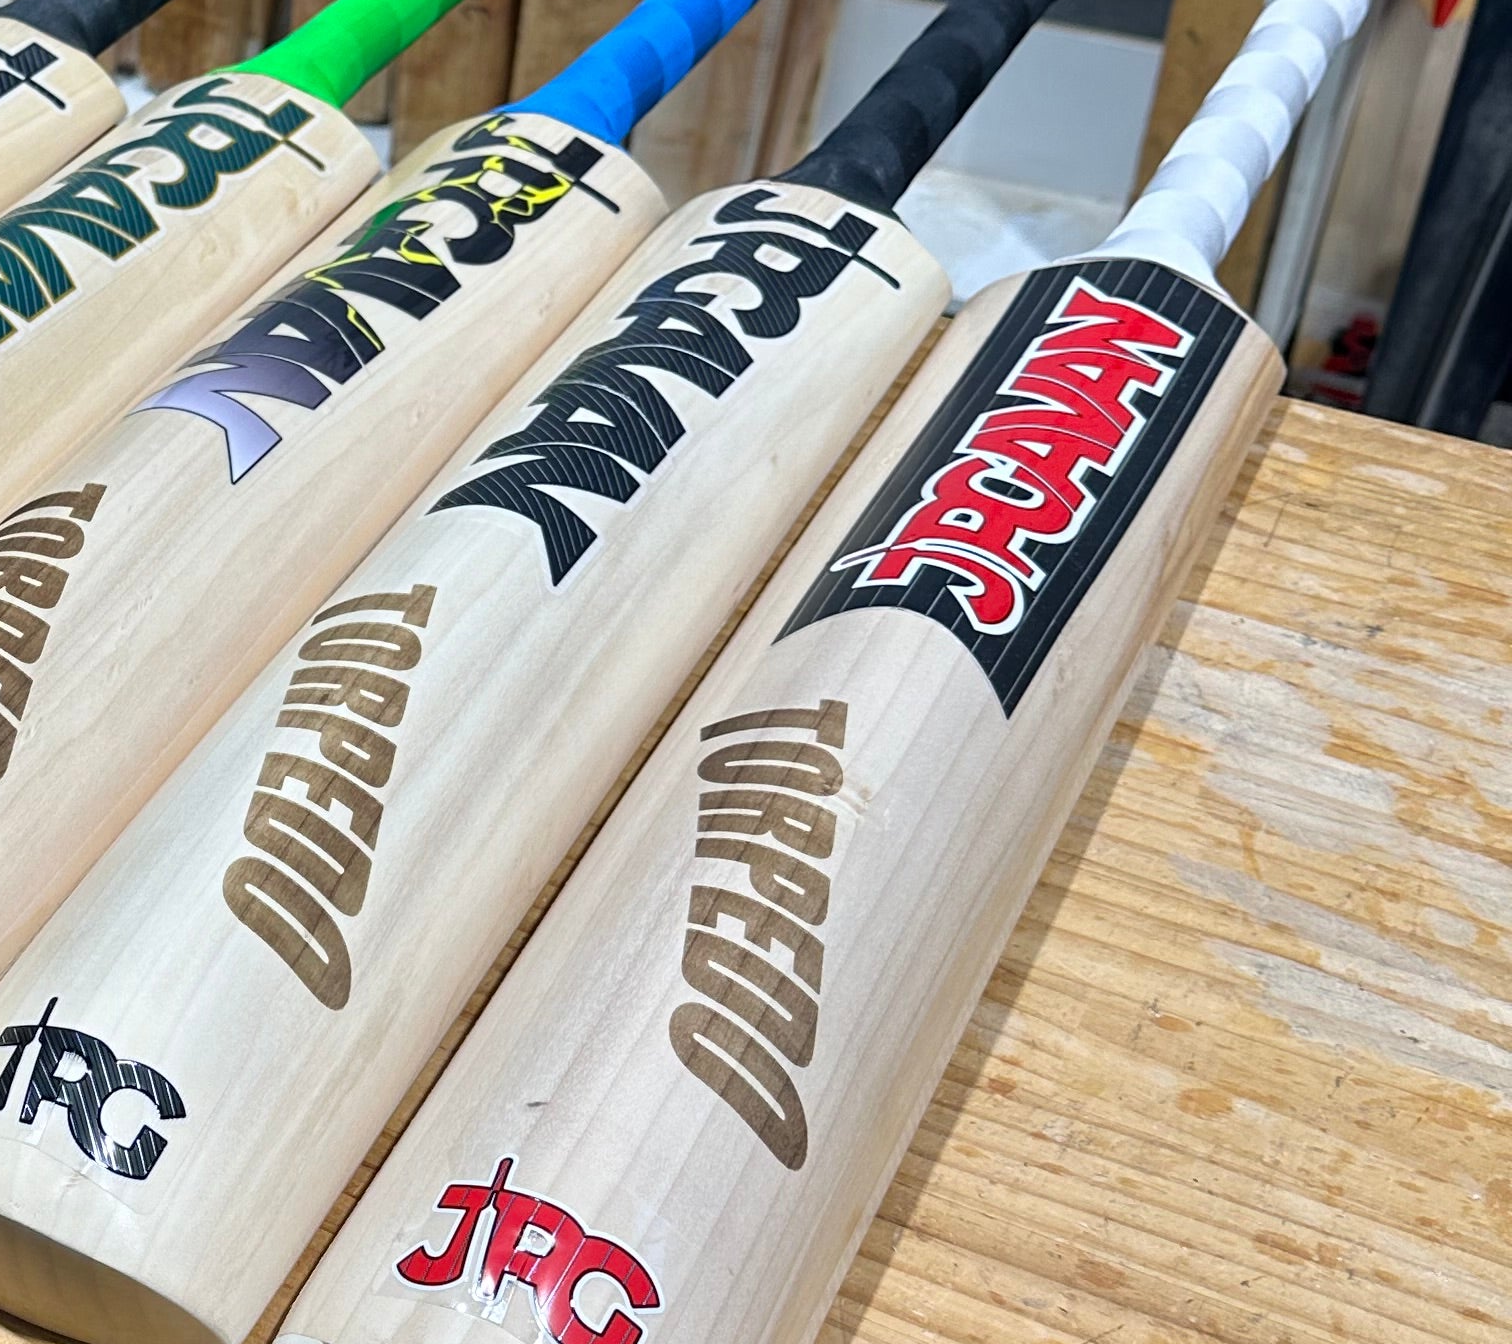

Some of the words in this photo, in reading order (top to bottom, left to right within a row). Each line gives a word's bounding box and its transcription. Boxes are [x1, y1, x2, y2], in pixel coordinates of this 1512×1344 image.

[126, 113, 620, 485] JPGAVAN
[426, 188, 901, 587] JPGAVAN
[829, 276, 1196, 636] JPGAVAN
[222, 583, 438, 1010] TORPEDO
[671, 699, 848, 1171] TORPEDO
